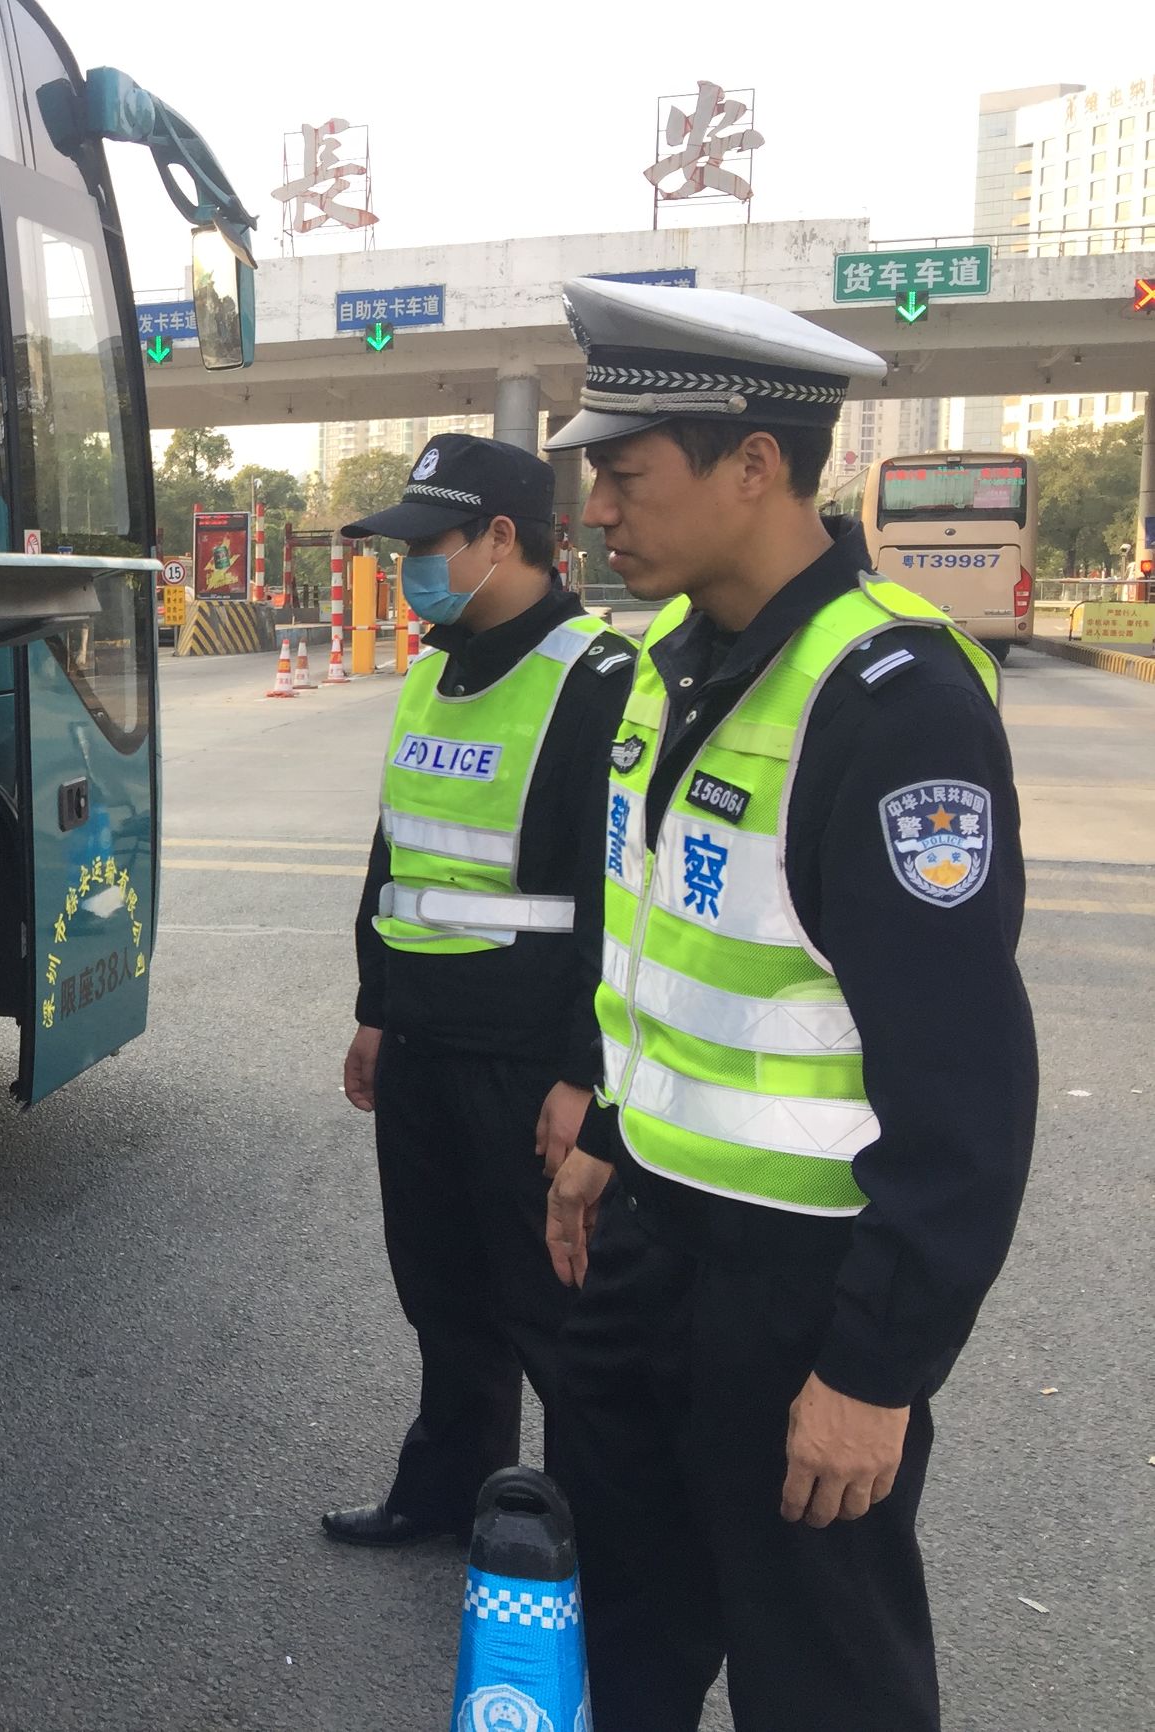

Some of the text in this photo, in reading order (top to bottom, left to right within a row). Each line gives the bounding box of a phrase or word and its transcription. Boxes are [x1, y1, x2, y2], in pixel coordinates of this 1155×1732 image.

[843, 256, 982, 294] 货车车道
[340, 294, 440, 322] 自助发卡车道
[168, 566, 182, 580] 15
[902, 554, 1001, 569] 粤T39987
[404, 741, 494, 774] POLICE
[691, 779, 745, 816] 156064
[886, 786, 985, 817] 中华人民共和国
[896, 813, 980, 839] 警 察
[921, 835, 964, 849] POLICE
[683, 833, 728, 919] 察
[60, 946, 133, 1021] 限座38人
